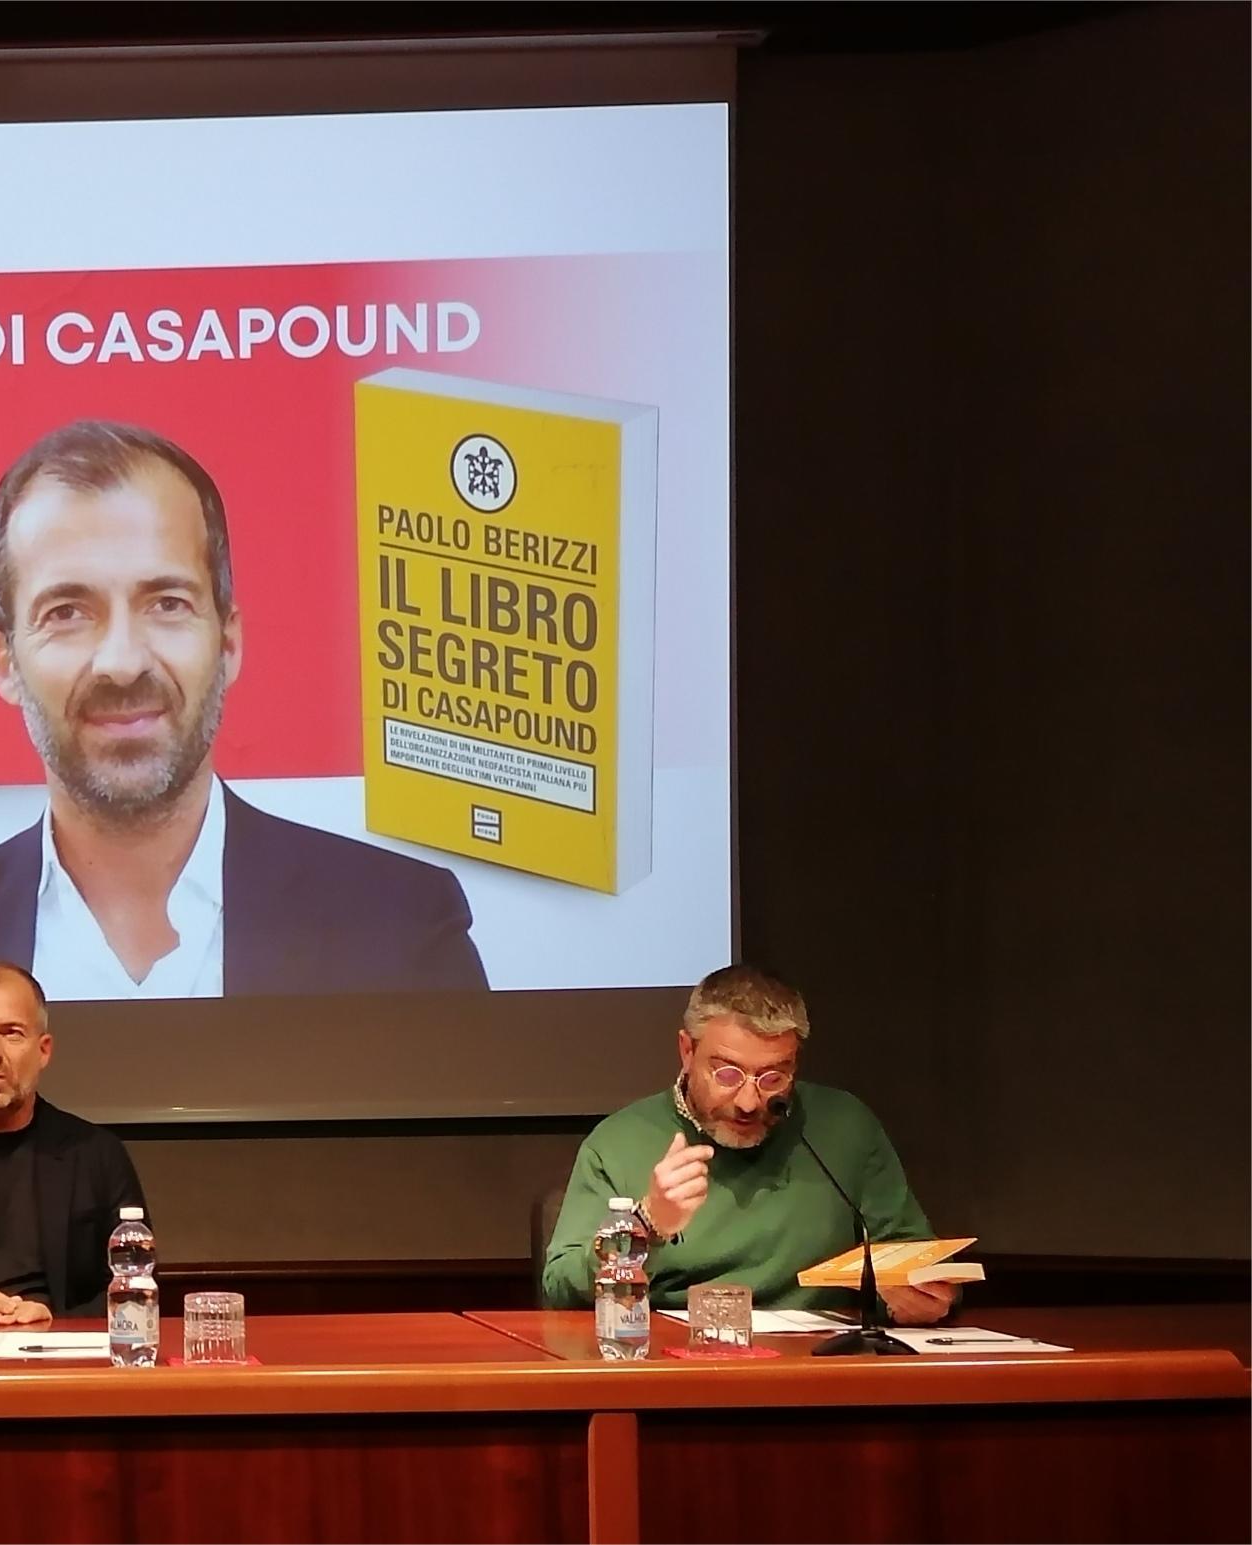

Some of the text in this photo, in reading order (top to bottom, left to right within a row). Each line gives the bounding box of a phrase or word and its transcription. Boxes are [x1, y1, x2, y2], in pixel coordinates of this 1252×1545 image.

[45, 301, 481, 366] CASAPOUND
[377, 503, 598, 575] PAOLO BERIZZI
[379, 554, 599, 652] IL LIBRO
[376, 619, 599, 714] SEGRETO
[382, 677, 598, 756] DI CASAPOUND
[389, 725, 587, 780] LE RIVELAZIONI DI UN MILITANTE DI PRIMO LIVELLO
[390, 750, 440, 770] IMPORTANTE
[441, 761, 464, 775] DEGLI
[464, 767, 492, 782] ULTIMI
[478, 759, 532, 780] NEOFASCISTA
[533, 771, 572, 790] ITALIANA
